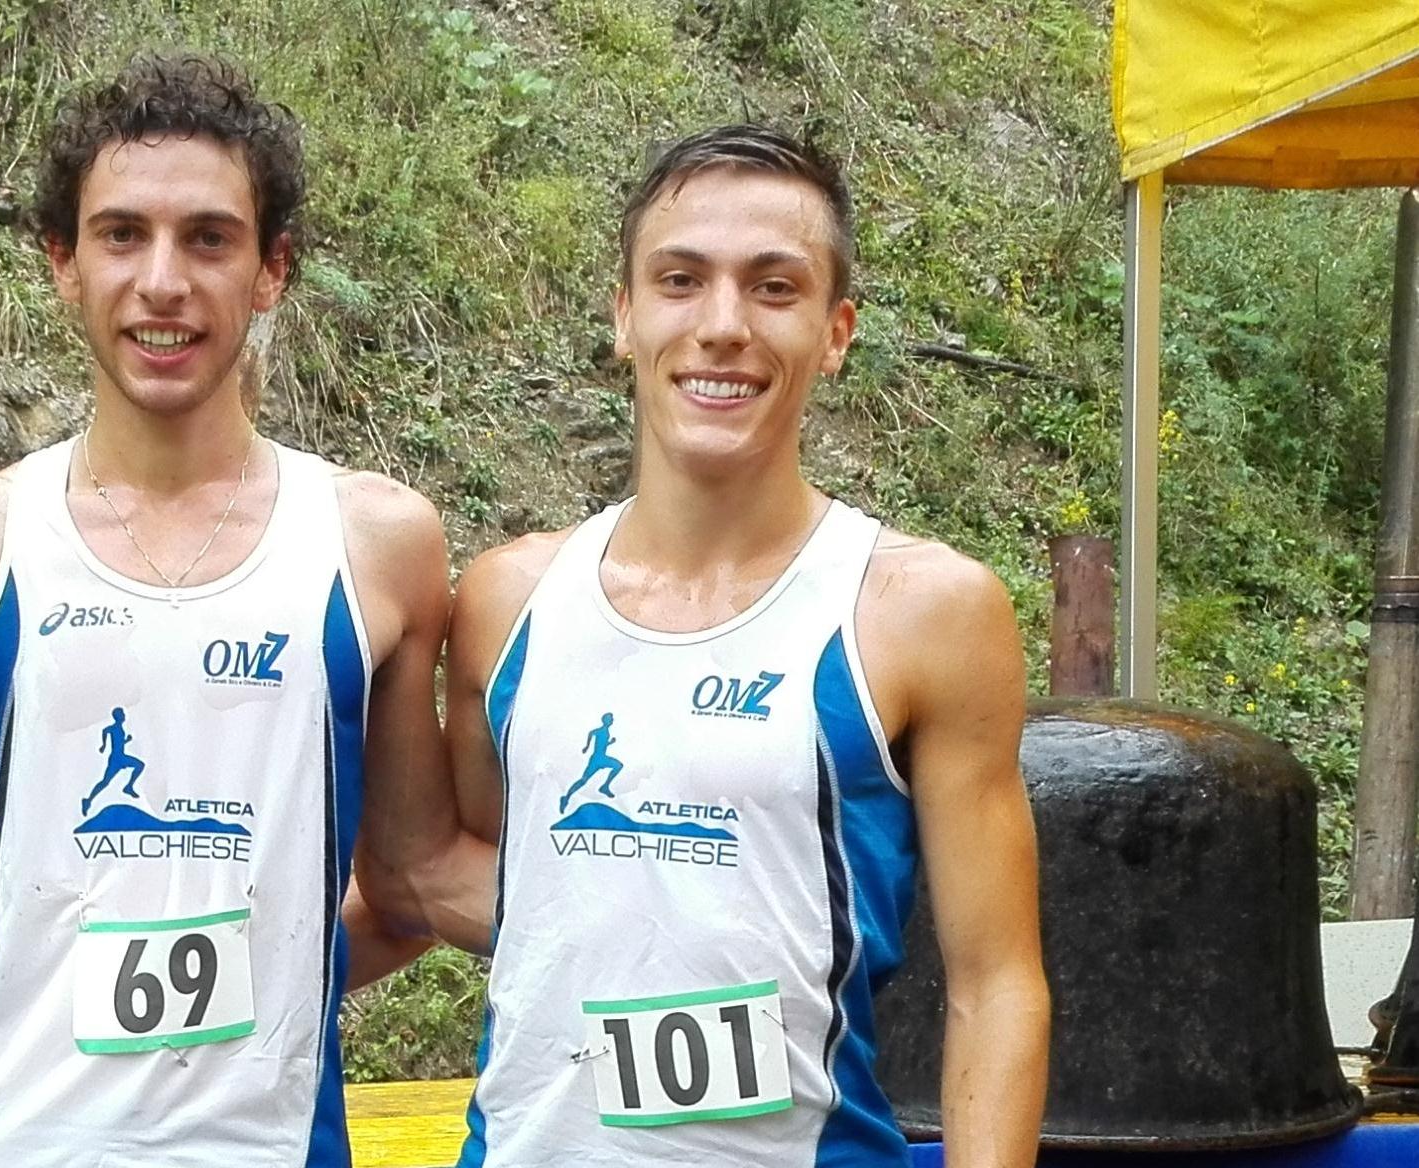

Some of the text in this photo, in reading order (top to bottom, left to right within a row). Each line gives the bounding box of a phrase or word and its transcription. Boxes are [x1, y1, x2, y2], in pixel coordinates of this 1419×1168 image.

[203, 631, 290, 682] OMZ
[692, 670, 786, 717] OMZ
[164, 799, 255, 817] ATLETICA
[637, 801, 739, 822] ATLETICA
[73, 833, 253, 863] VALCHIESE
[549, 832, 739, 867] VALCHIESE
[114, 933, 218, 1034] 69
[603, 1004, 759, 1109] 101
